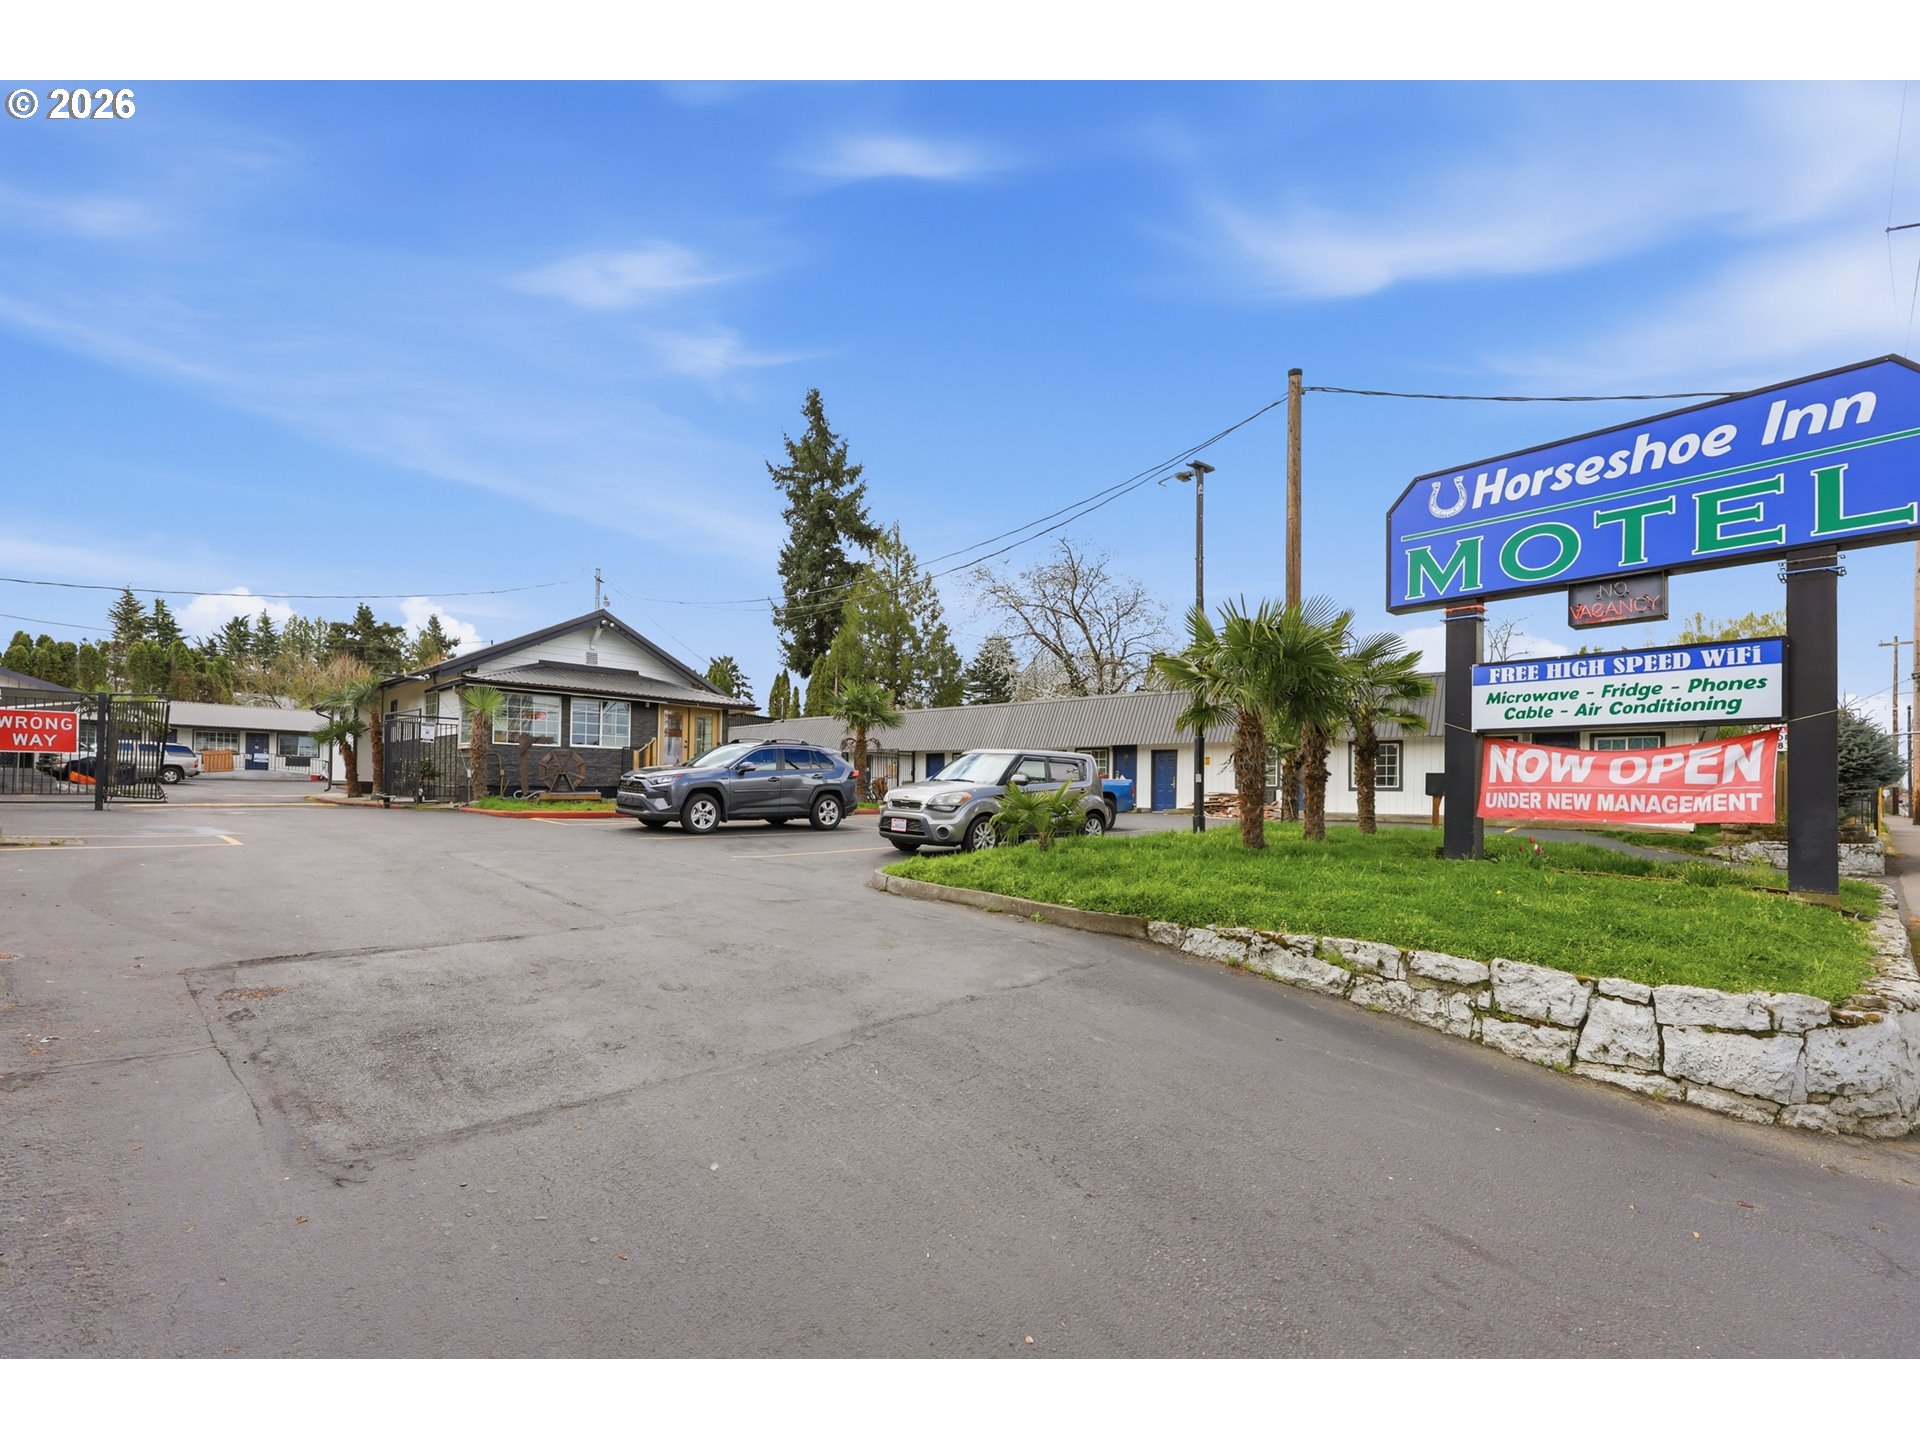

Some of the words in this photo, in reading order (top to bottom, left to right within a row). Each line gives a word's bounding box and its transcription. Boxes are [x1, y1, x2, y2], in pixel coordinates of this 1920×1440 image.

[1471, 424, 1738, 510] Horseshoe
[1761, 390, 1877, 446] Inn
[1404, 462, 1919, 601] MOTEL
[1597, 581, 1629, 600] NO
[1569, 594, 1660, 620] VACANCY
[1488, 664, 1539, 684] FREE
[1546, 658, 1605, 680] HIGH
[1613, 652, 1691, 675] SPEED
[1700, 645, 1761, 668] WiFi
[1486, 689, 1579, 705] Microwave
[1601, 682, 1663, 701] Fridge
[1687, 677, 1768, 693] Phones
[1503, 706, 1554, 720] Cable
[1574, 702, 1602, 717] Air
[1608, 695, 1742, 715] Conditioning
[0, 715, 73, 731] WRONG
[12, 733, 57, 747] WAY
[1488, 744, 1596, 783] NOW
[1608, 738, 1766, 784] OPEN
[1485, 792, 1542, 809] UNDER
[1547, 793, 1592, 811] NEW
[1596, 792, 1763, 814] MANAGEMENT
